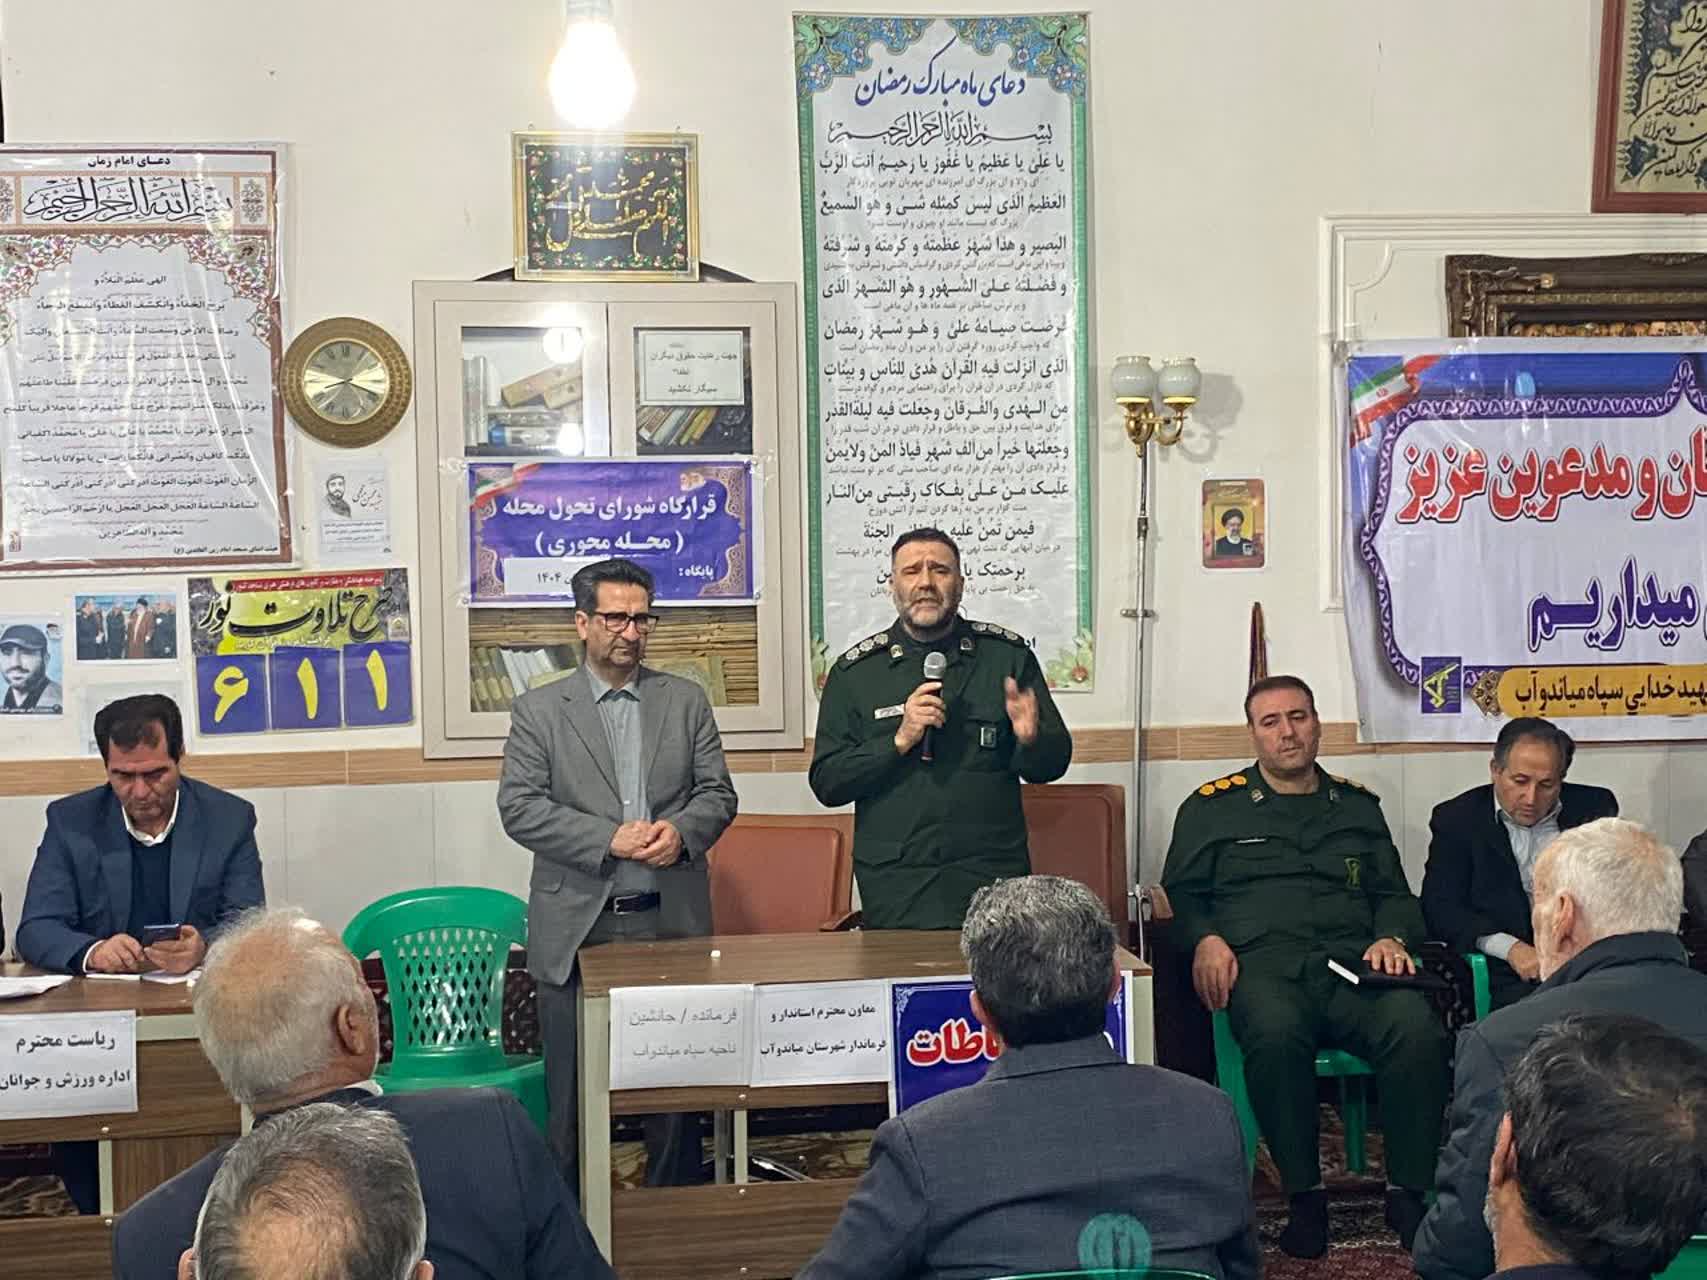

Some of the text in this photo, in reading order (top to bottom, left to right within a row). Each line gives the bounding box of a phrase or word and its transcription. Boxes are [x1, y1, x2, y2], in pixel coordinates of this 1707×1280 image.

[854, 36, 1025, 107] دعای ماه مبارک رمضان
[965, 119, 1053, 146] بسم
[87, 155, 171, 168] دعای امام زمان
[878, 155, 915, 175] رحیم
[919, 153, 928, 172] یا
[933, 150, 961, 174] غفور
[965, 152, 974, 172] یا
[979, 153, 1010, 173] عظیم
[1015, 152, 1024, 172] یا
[1028, 148, 1051, 174] علی
[1056, 152, 1065, 172] یا
[885, 201, 892, 215] و
[965, 195, 992, 215] لیس
[996, 193, 1024, 215] الذی
[1028, 192, 1066, 213] العظیم
[864, 243, 871, 257] و
[913, 243, 919, 256] و
[965, 236, 992, 256] شهر
[996, 236, 1016, 251] هذا
[1020, 243, 1026, 256] و
[1030, 235, 1067, 256] البصیر
[822, 279, 850, 298] الذی
[853, 278, 896, 299] الشهر
[900, 279, 915, 299] هو
[918, 285, 926, 298] و
[928, 276, 977, 299] الشهور
[980, 279, 1011, 298] علی
[1060, 283, 1067, 296] و
[823, 320, 865, 340] رمضان
[869, 320, 904, 340] شهر
[907, 320, 930, 340] هو
[932, 322, 940, 339] و
[947, 320, 970, 340] علی
[859, 367, 866, 380] و
[869, 360, 905, 381] للناس
[981, 360, 1000, 378] فیه
[1039, 359, 1068, 378] الذی
[876, 402, 896, 421] فیه
[1050, 403, 1068, 420] من
[925, 441, 952, 462] شهر
[1396, 441, 1488, 523] عزیز
[1489, 437, 1633, 522] مدعوین
[1632, 455, 1658, 520] و
[967, 480, 998, 501] علی
[1030, 481, 1069, 499] علیک
[502, 494, 717, 520] قرارگاه شورای تحول محله
[950, 520, 974, 540] علیه
[537, 572, 562, 584] ۱۴۰۴
[964, 560, 1025, 581] برحمتک یا
[228, 588, 349, 638] تلاوت
[1528, 554, 1700, 652] میداریم
[1514, 671, 1586, 717] میاندوآب
[1586, 674, 1624, 714] سپاه
[629, 1008, 676, 1026] جانشین
[691, 1007, 736, 1024] فرمانده
[770, 1003, 876, 1022] معاون محترم استاندار و
[15, 1030, 116, 1054] ریاست محترم
[759, 1038, 888, 1057] فرماندار شهرستان میاندوآب
[906, 1018, 1001, 1067] اطات
[0, 1069, 131, 1090] اداره ورزش و جوانان
